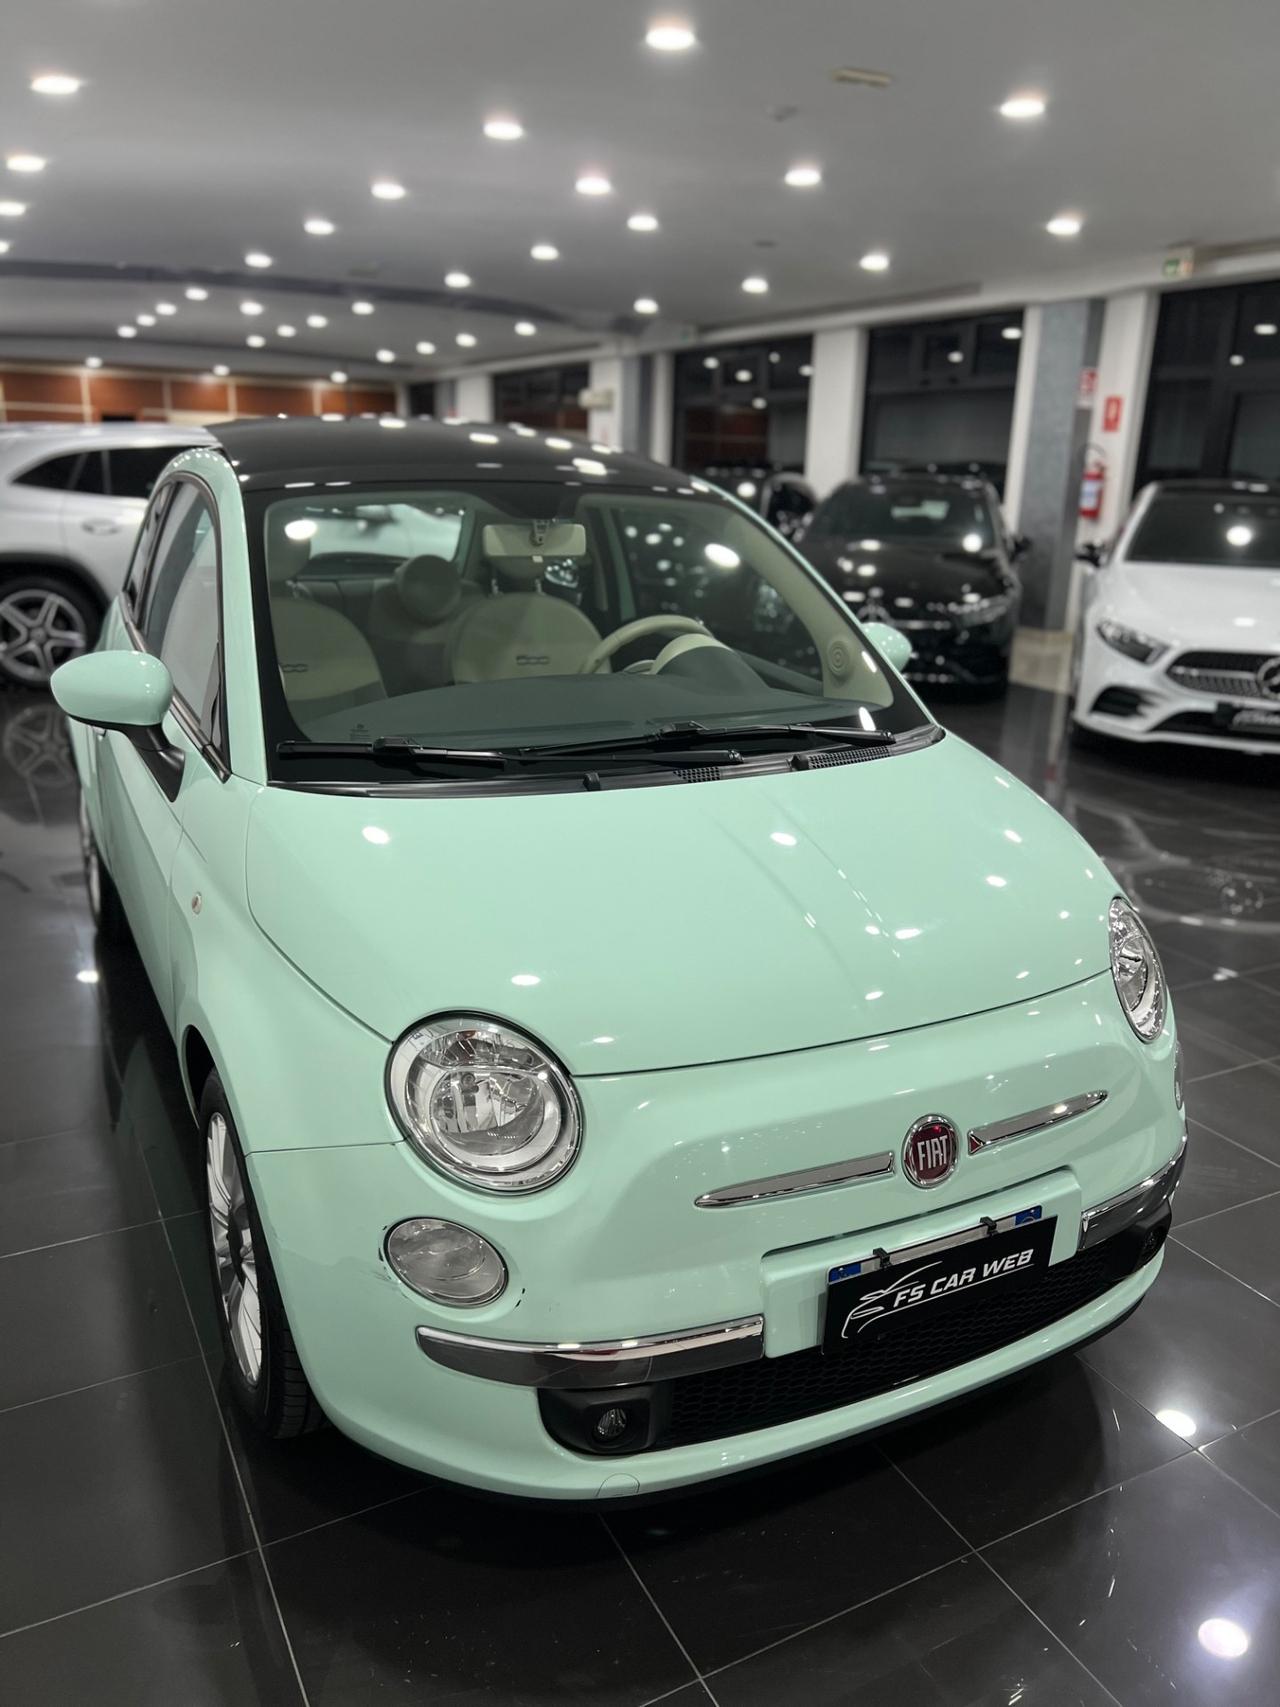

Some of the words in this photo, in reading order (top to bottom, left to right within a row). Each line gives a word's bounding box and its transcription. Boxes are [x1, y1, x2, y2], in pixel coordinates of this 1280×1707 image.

[917, 1134, 948, 1171] FIAT
[893, 1284, 926, 1308] FS
[930, 1267, 976, 1295] CAR
[982, 1248, 1034, 1277] WEB
